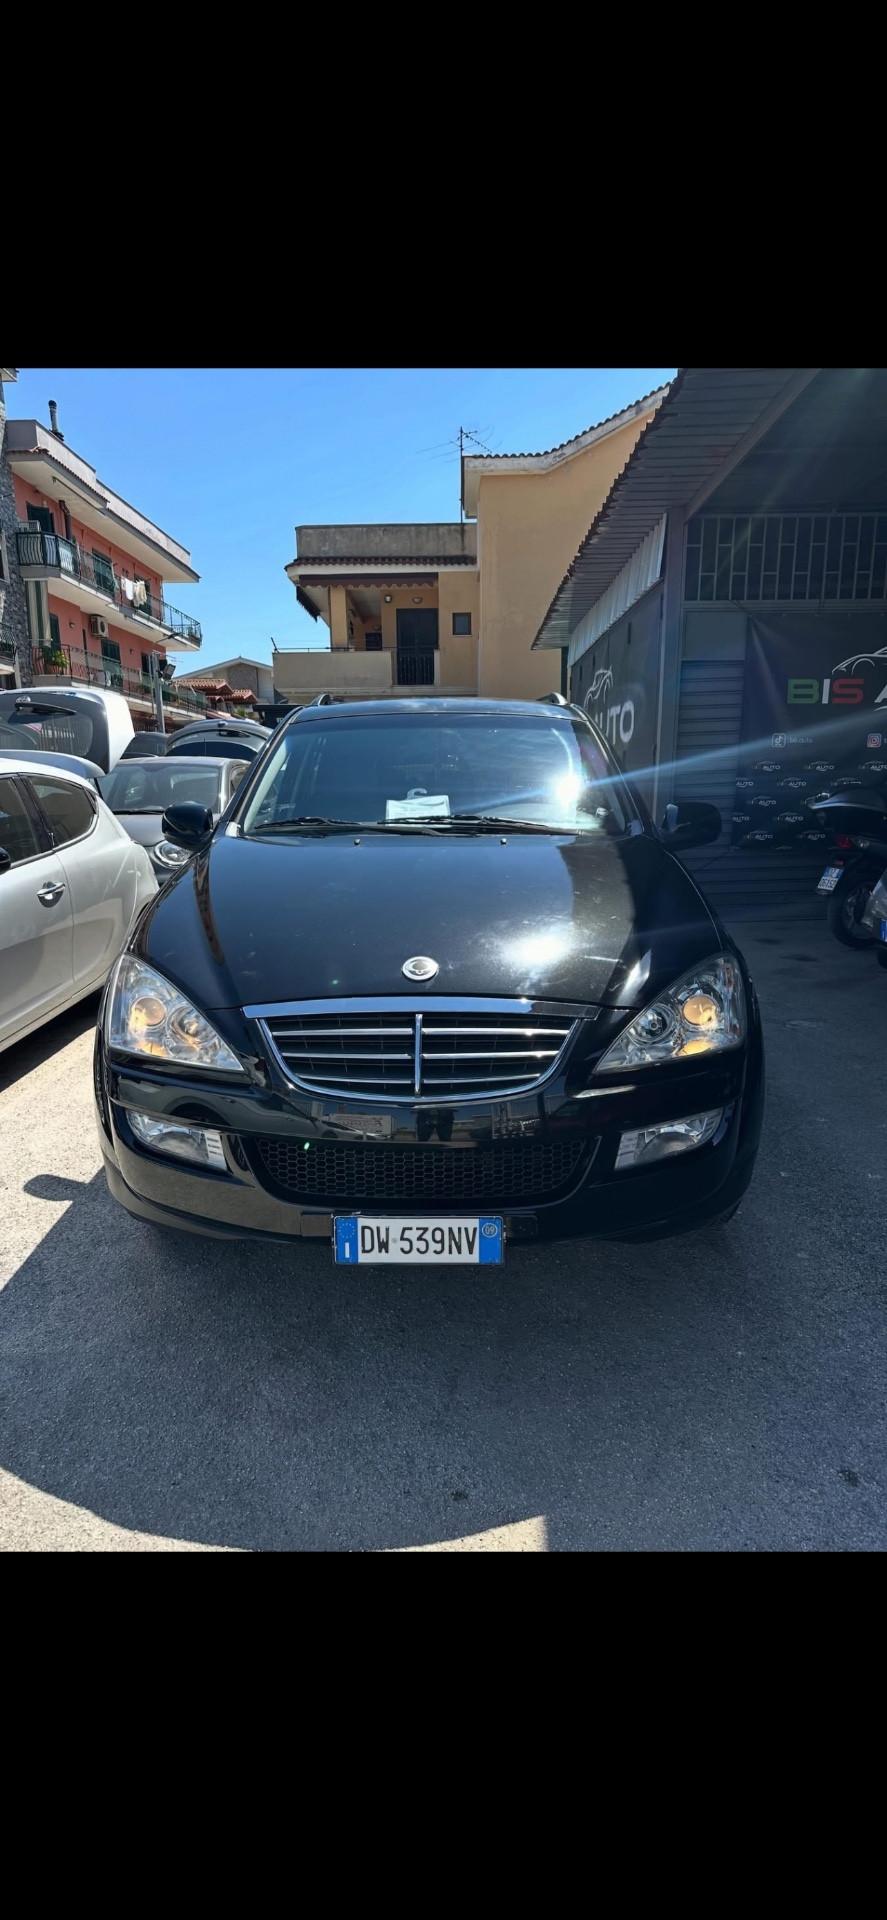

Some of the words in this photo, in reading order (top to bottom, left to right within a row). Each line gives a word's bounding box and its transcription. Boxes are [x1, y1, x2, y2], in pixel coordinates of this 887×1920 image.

[787, 678, 865, 704] BIS
[345, 1243, 350, 1258] I
[361, 1225, 389, 1254] DW
[399, 1226, 477, 1254] 539NV
